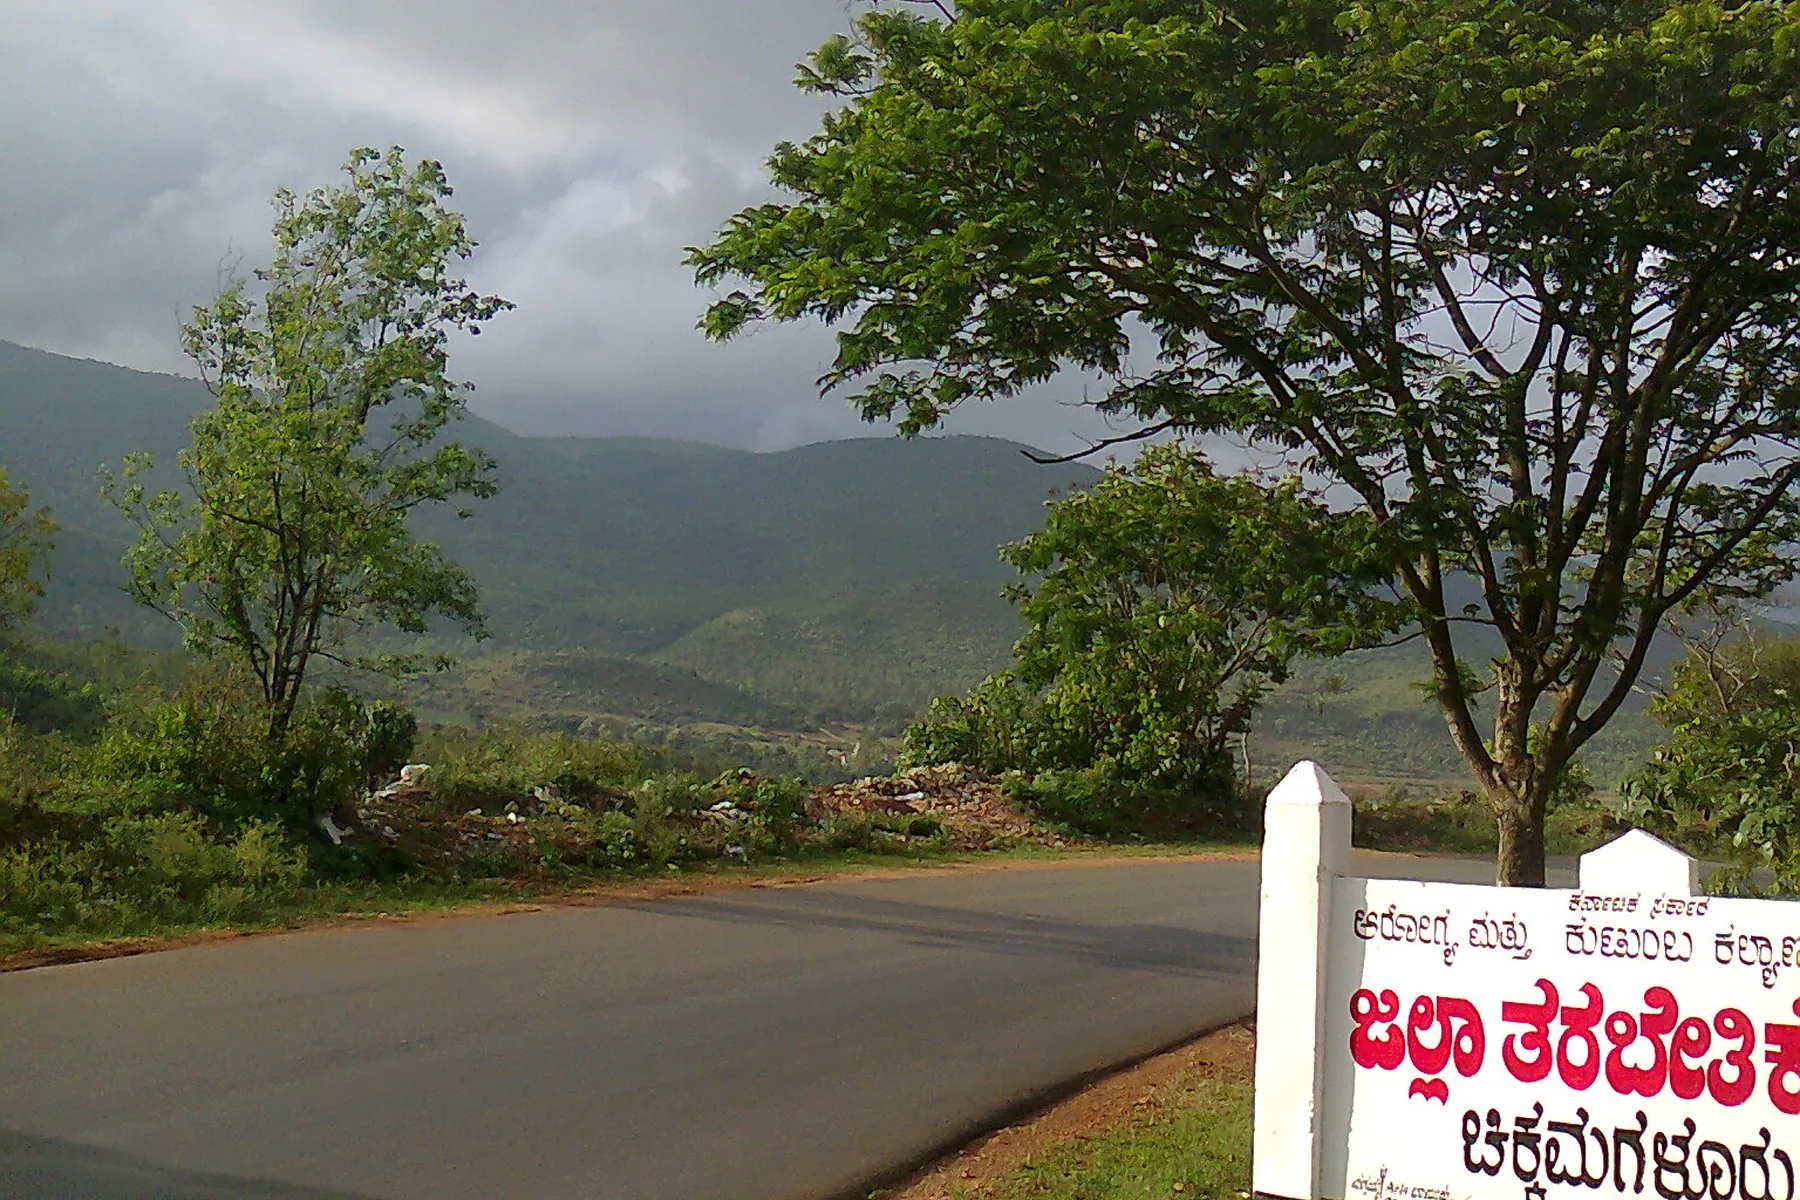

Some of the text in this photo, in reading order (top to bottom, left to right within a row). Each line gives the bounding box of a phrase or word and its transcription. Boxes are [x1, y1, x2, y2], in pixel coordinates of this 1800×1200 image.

[1354, 903, 1460, 968] ಆರೋಗ್ಯ
[1469, 910, 1533, 961] ಮತ್ತು
[1565, 915, 1693, 963] ಕುಟುಂಬ
[1569, 890, 1710, 920] ಕರ್ನಾಟಕ ಸರ್ಕಾರ
[1349, 988, 1486, 1107] ಜಿಲ್ಲಾ
